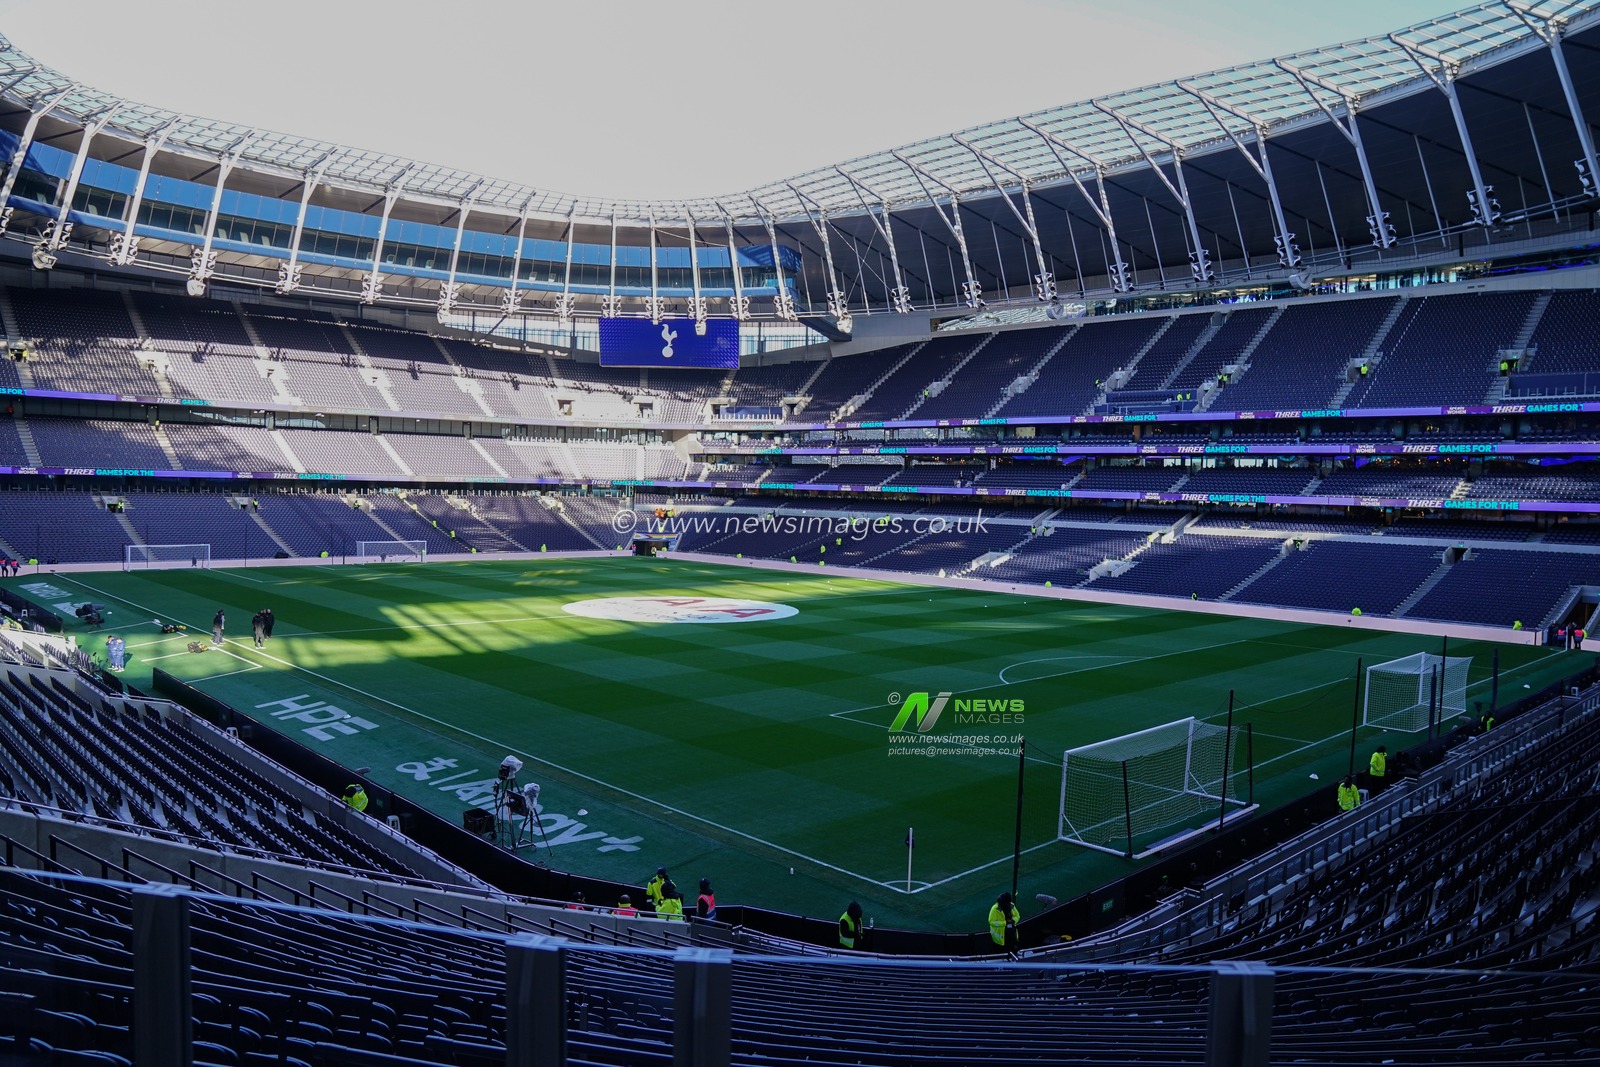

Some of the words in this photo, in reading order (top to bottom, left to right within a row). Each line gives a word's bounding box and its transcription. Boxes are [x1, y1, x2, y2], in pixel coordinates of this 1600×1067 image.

[1408, 500, 1443, 508] THREE
[1444, 501, 1476, 509] GAMES
[254, 694, 380, 742] HPE
